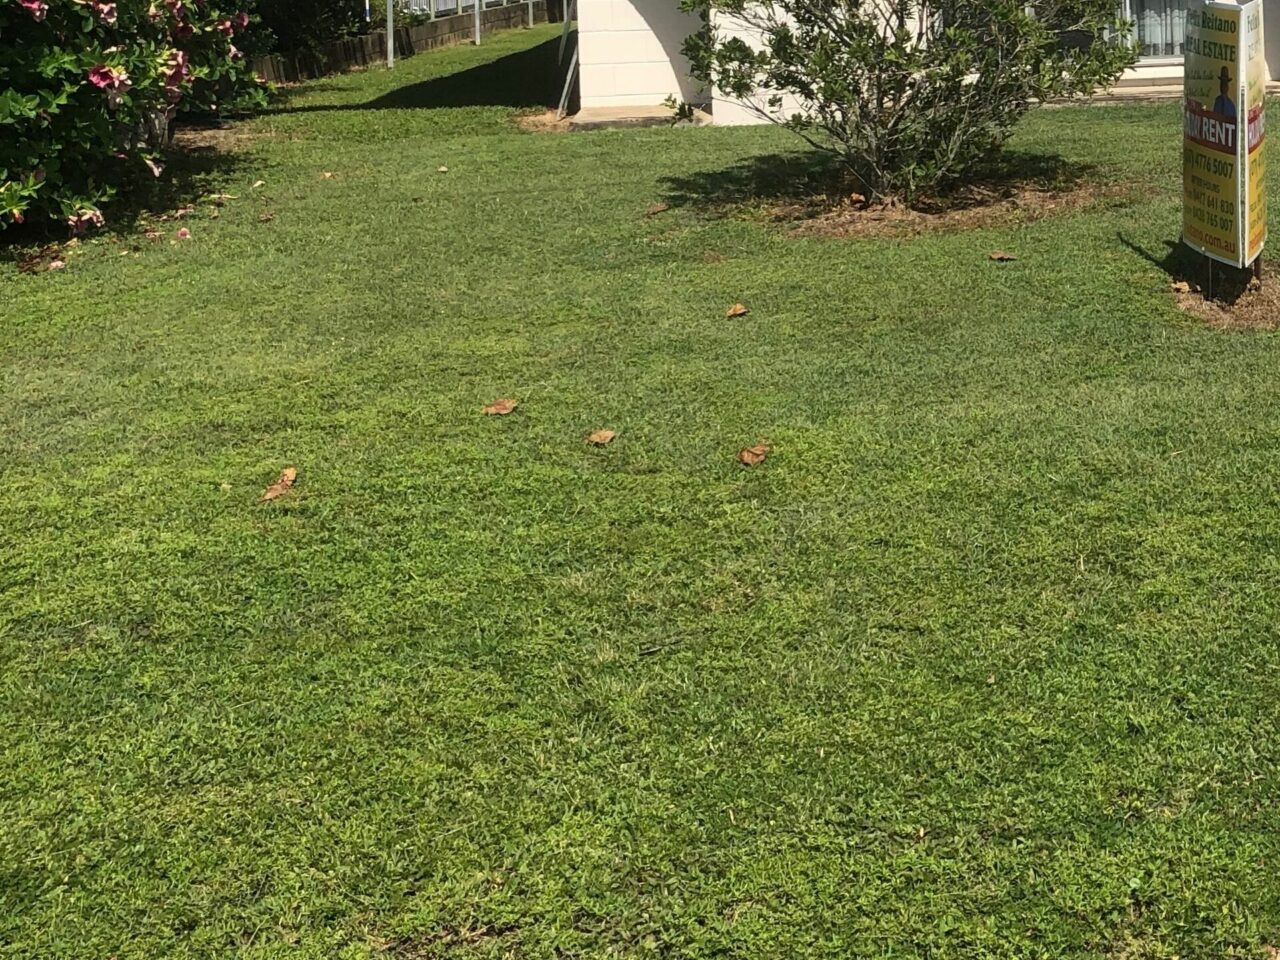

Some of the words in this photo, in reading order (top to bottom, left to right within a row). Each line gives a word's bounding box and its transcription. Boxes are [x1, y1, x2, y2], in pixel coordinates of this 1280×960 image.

[1201, 11, 1237, 33] Reitano
[1203, 40, 1236, 62] ESTATE
[1202, 117, 1236, 148] RENT
[1213, 159, 1234, 179] 5007
[1220, 201, 1235, 216] 830
[1220, 217, 1234, 233] 007
